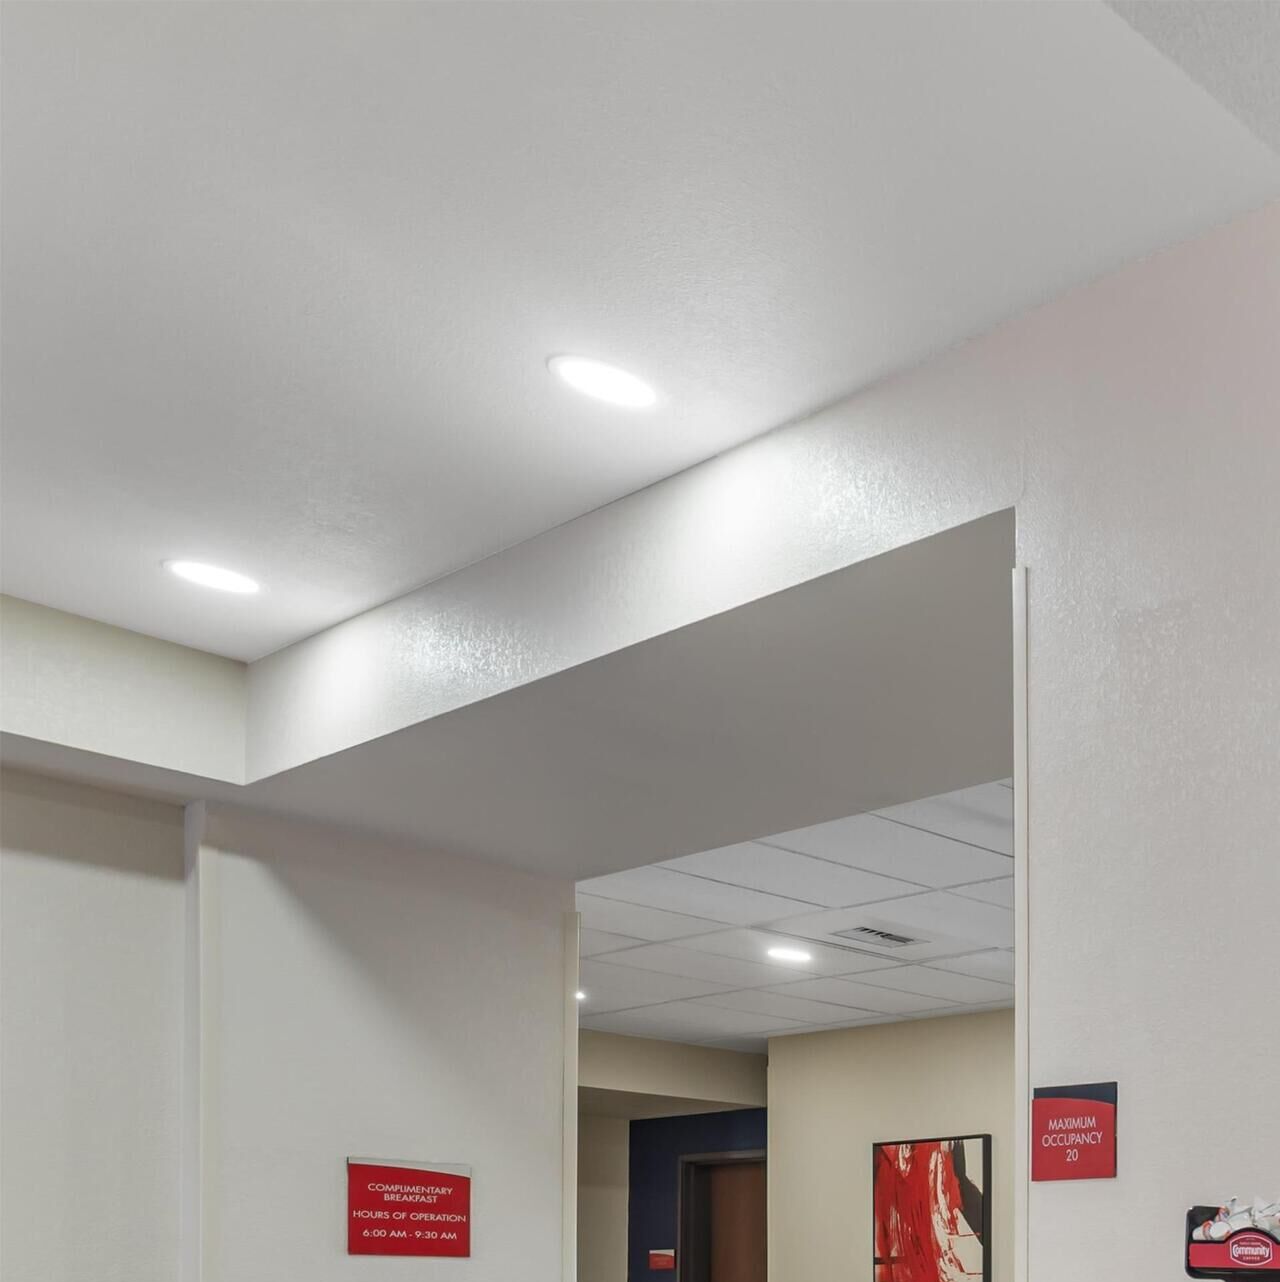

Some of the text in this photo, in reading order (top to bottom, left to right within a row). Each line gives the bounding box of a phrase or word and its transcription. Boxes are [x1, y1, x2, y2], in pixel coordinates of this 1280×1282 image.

[1048, 1116, 1096, 1130] MAXIMUM
[1042, 1132, 1102, 1146] OCCUPANCY
[1066, 1149, 1078, 1161] 20
[368, 1183, 453, 1195] COMPLIMENTARY
[384, 1193, 437, 1203] BREAKFAST
[353, 1210, 466, 1222] HOURS OF OPERATION
[390, 1230, 407, 1238] AM
[415, 1231, 437, 1239] 9:30
[440, 1232, 457, 1240] AM
[1232, 1244, 1269, 1258] Community
